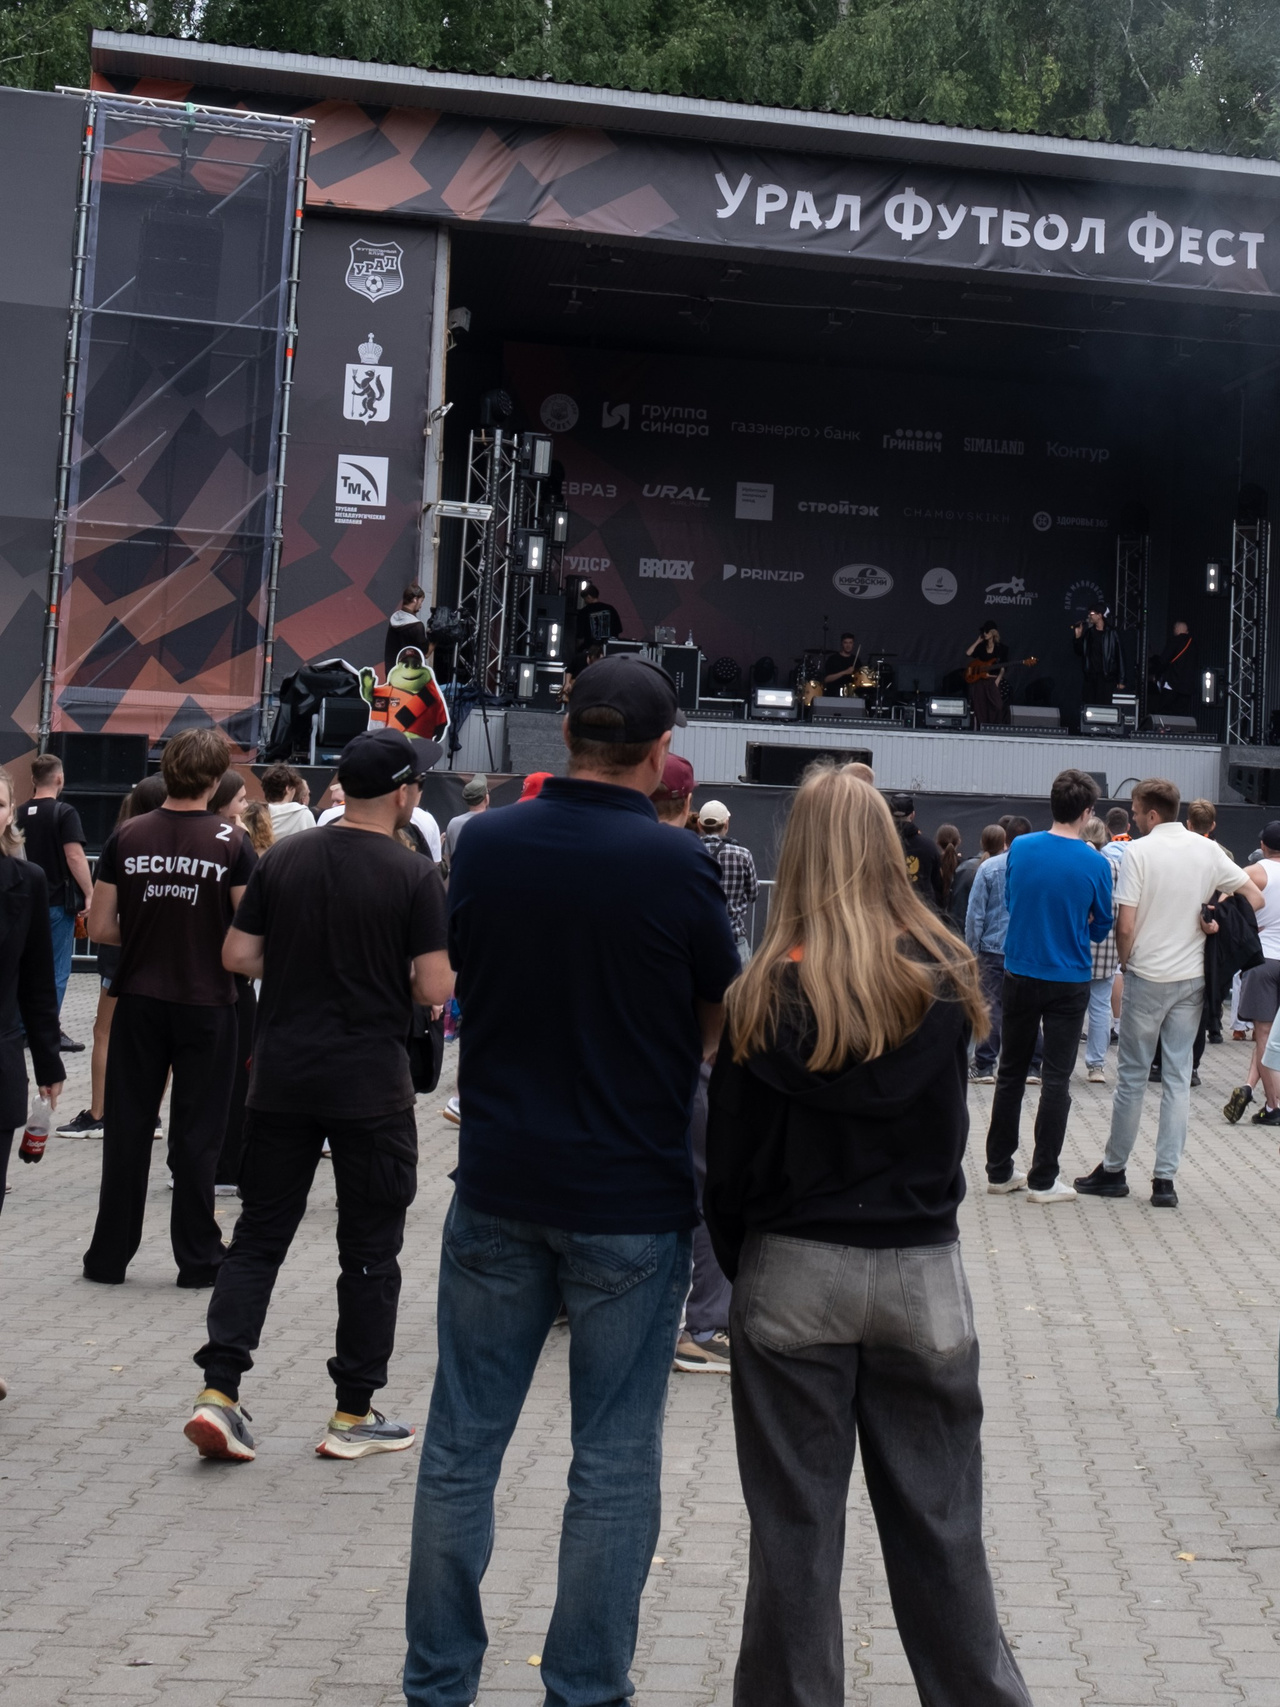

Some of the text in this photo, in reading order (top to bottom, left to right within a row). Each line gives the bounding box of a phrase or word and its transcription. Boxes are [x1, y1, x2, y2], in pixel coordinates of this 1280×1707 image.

[714, 171, 1265, 270] УРАЛ ФУТБОЛ ФЕСТ
[353, 255, 397, 277] УРАЛ
[641, 403, 708, 422] группа
[640, 420, 710, 438] синара
[730, 420, 861, 441] газэнерго банк
[963, 437, 1025, 456] SIMALAND
[1046, 441, 1110, 463] Контур
[340, 475, 371, 502] ТМК
[561, 481, 618, 499] ЕВРАЗ
[641, 483, 712, 502] URAL
[797, 500, 880, 517] СТРОЙТЭК
[903, 506, 1011, 525] CHAMOVSKIKH
[1056, 515, 1094, 528] ЗДОРОВЬЕ
[564, 555, 611, 573] УДСР
[638, 557, 695, 581] BROZEX
[740, 567, 806, 583] PRINZIP
[838, 576, 888, 587] КИРОВСКИЙ
[215, 823, 234, 842] 2
[124, 855, 228, 882] SECURITY
